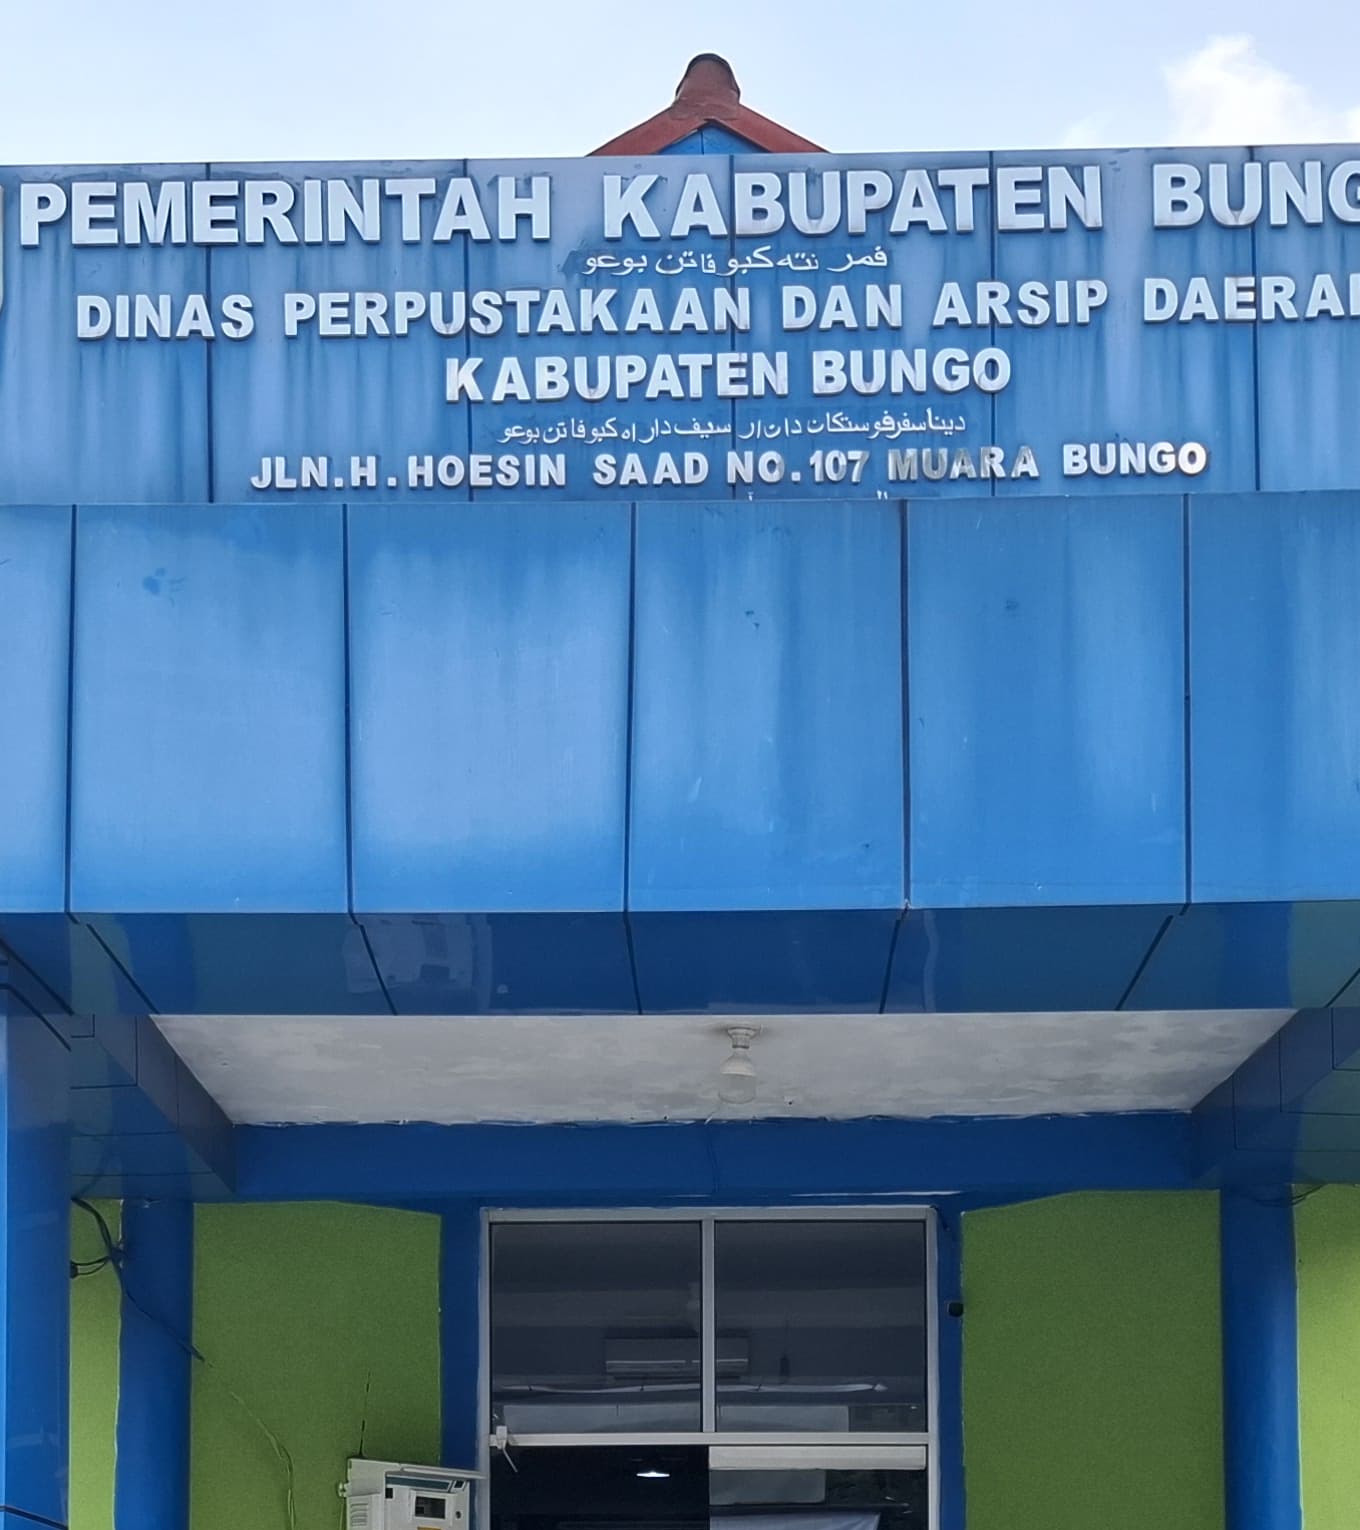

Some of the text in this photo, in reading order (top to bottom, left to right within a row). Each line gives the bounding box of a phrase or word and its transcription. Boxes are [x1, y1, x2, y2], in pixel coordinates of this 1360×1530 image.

[20, 175, 551, 247] PEMERINTAH
[605, 165, 1103, 240] KABUPATEN
[77, 294, 255, 340] DINAS
[284, 287, 751, 337] PERPUSTAKAAN
[782, 284, 903, 330] DAN
[932, 279, 1109, 326] ARSIP
[446, 347, 1012, 402] KABUPATEN BUNGO
[592, 452, 710, 485] SAAD
[887, 446, 1041, 481] MUARA
[1063, 441, 1208, 476] BUNGO
